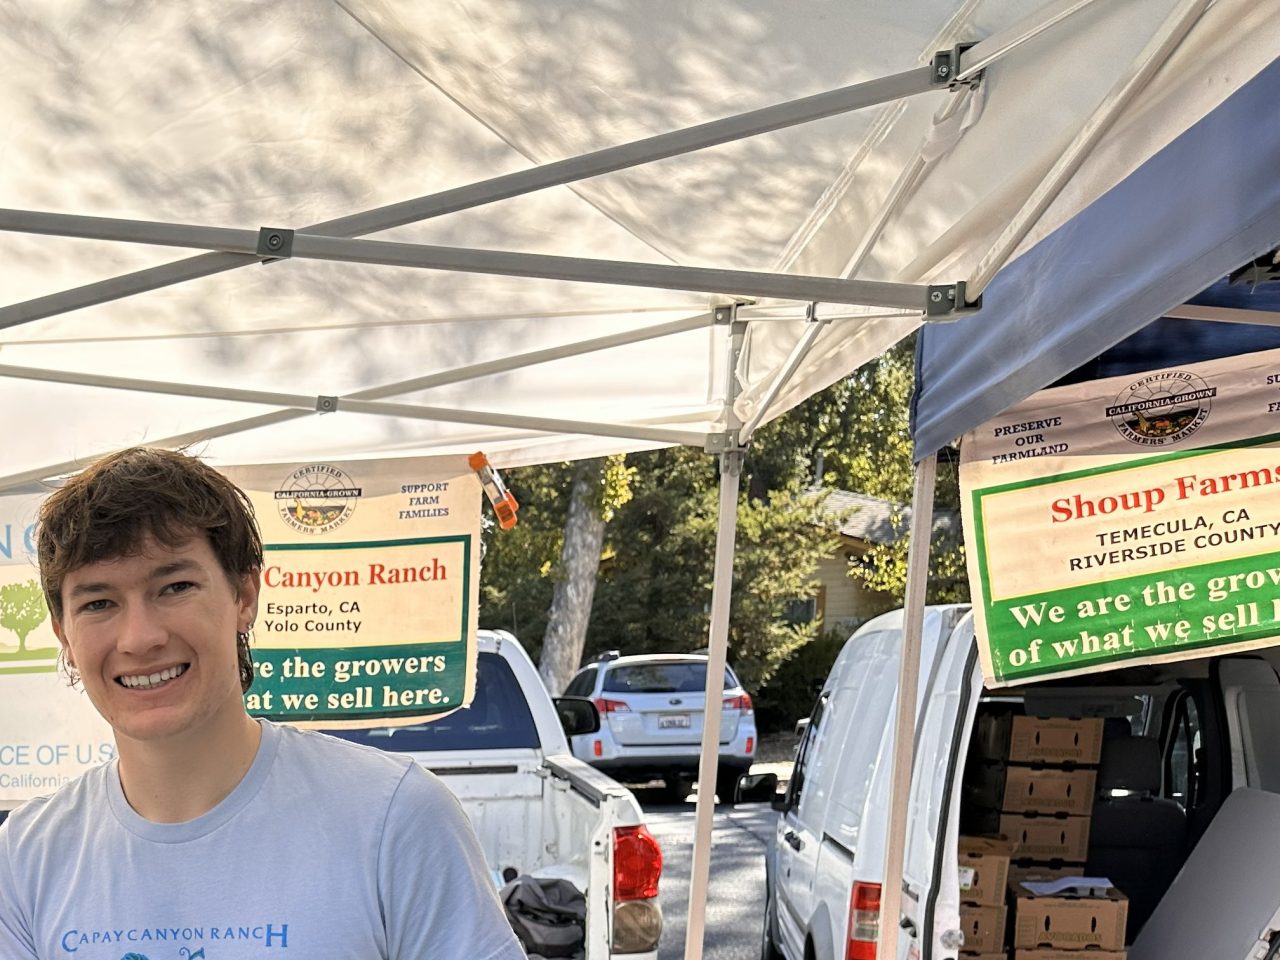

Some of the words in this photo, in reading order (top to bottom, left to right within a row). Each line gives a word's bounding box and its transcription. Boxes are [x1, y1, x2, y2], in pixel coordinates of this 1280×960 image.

[1130, 372, 1192, 391] CERTIFIED
[994, 417, 1062, 437] PRESERVE
[1118, 422, 1167, 445] FARMERS'
[1172, 408, 1208, 442] MARKET
[1015, 433, 1044, 447] OUR
[992, 443, 1069, 465] FARMLAND
[293, 465, 342, 480] CERTIFIED
[401, 482, 449, 494] SUPPORT
[409, 495, 440, 506] FARM
[1051, 488, 1165, 525] Shoup
[320, 506, 353, 534] MARKET
[399, 507, 450, 520] FAMILIES
[1096, 516, 1214, 547] TEMECULA,
[1222, 508, 1251, 524] CA
[1069, 539, 1187, 571] RIVERSIDE
[1193, 522, 1280, 549] COUNTY
[264, 565, 360, 592] Canyon
[367, 558, 448, 586] Ranch
[267, 602, 333, 618] Esparto,
[339, 601, 361, 614] CA
[1009, 601, 1066, 630] We
[1077, 592, 1131, 617] are
[1142, 579, 1196, 608] the
[264, 620, 299, 632] Yolo
[304, 620, 362, 633] County
[1008, 639, 1043, 668] of
[1052, 628, 1135, 659] what
[1145, 617, 1192, 643] we
[1202, 602, 1259, 634] sell
[282, 656, 326, 678] the
[334, 655, 446, 683] growers
[281, 692, 319, 710] we
[327, 686, 373, 708] sell
[382, 685, 450, 707] here.
[36, 744, 70, 766] OF
[61, 929, 124, 952] CAPAY
[127, 926, 205, 942] CANYON
[210, 923, 289, 948] RANCH
